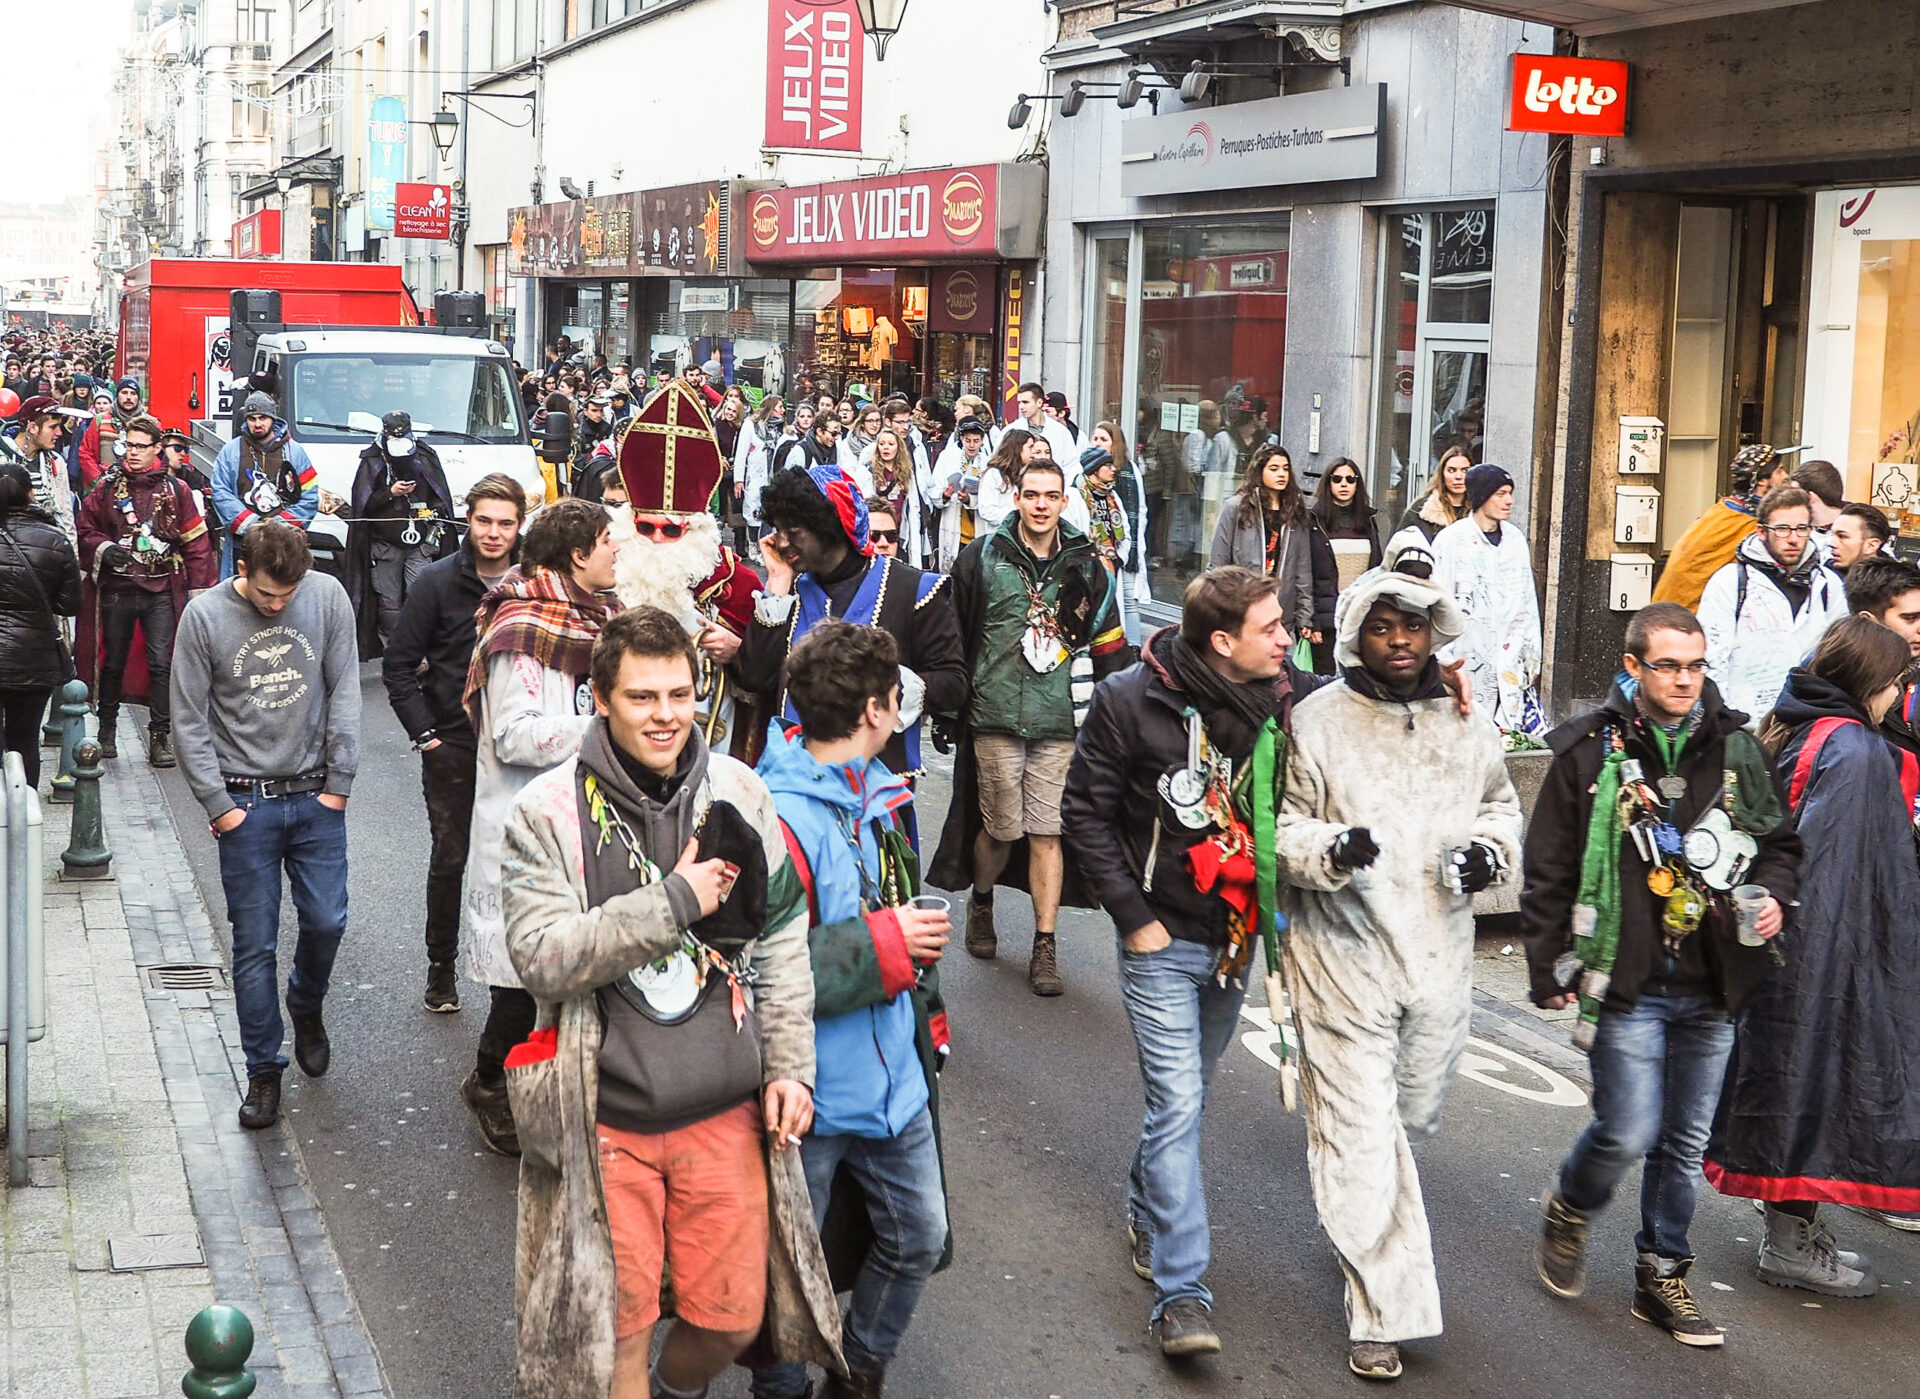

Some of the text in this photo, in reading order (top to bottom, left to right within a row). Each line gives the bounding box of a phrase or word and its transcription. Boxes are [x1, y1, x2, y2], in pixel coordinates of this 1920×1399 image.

[782, 9, 814, 141] JEUX
[818, 11, 850, 141] VIDEO
[370, 120, 407, 143] TUNG
[1220, 129, 1324, 157] Perruques-Postiches-Turbans
[399, 205, 446, 218] CLEAN IN
[786, 184, 931, 244] JEUX VIDEO
[399, 220, 429, 229] nettoyage
[402, 226, 442, 235] blanchisserie
[1853, 228, 1871, 236] bpost
[1006, 269, 1022, 402] VIDEO
[1652, 428, 1658, 440] 3
[1629, 455, 1636, 471] 8
[1649, 498, 1654, 509] 2
[1625, 525, 1633, 541] 8
[1644, 565, 1648, 576] 1
[1620, 593, 1628, 609] 8
[250, 667, 302, 688] Bench.
